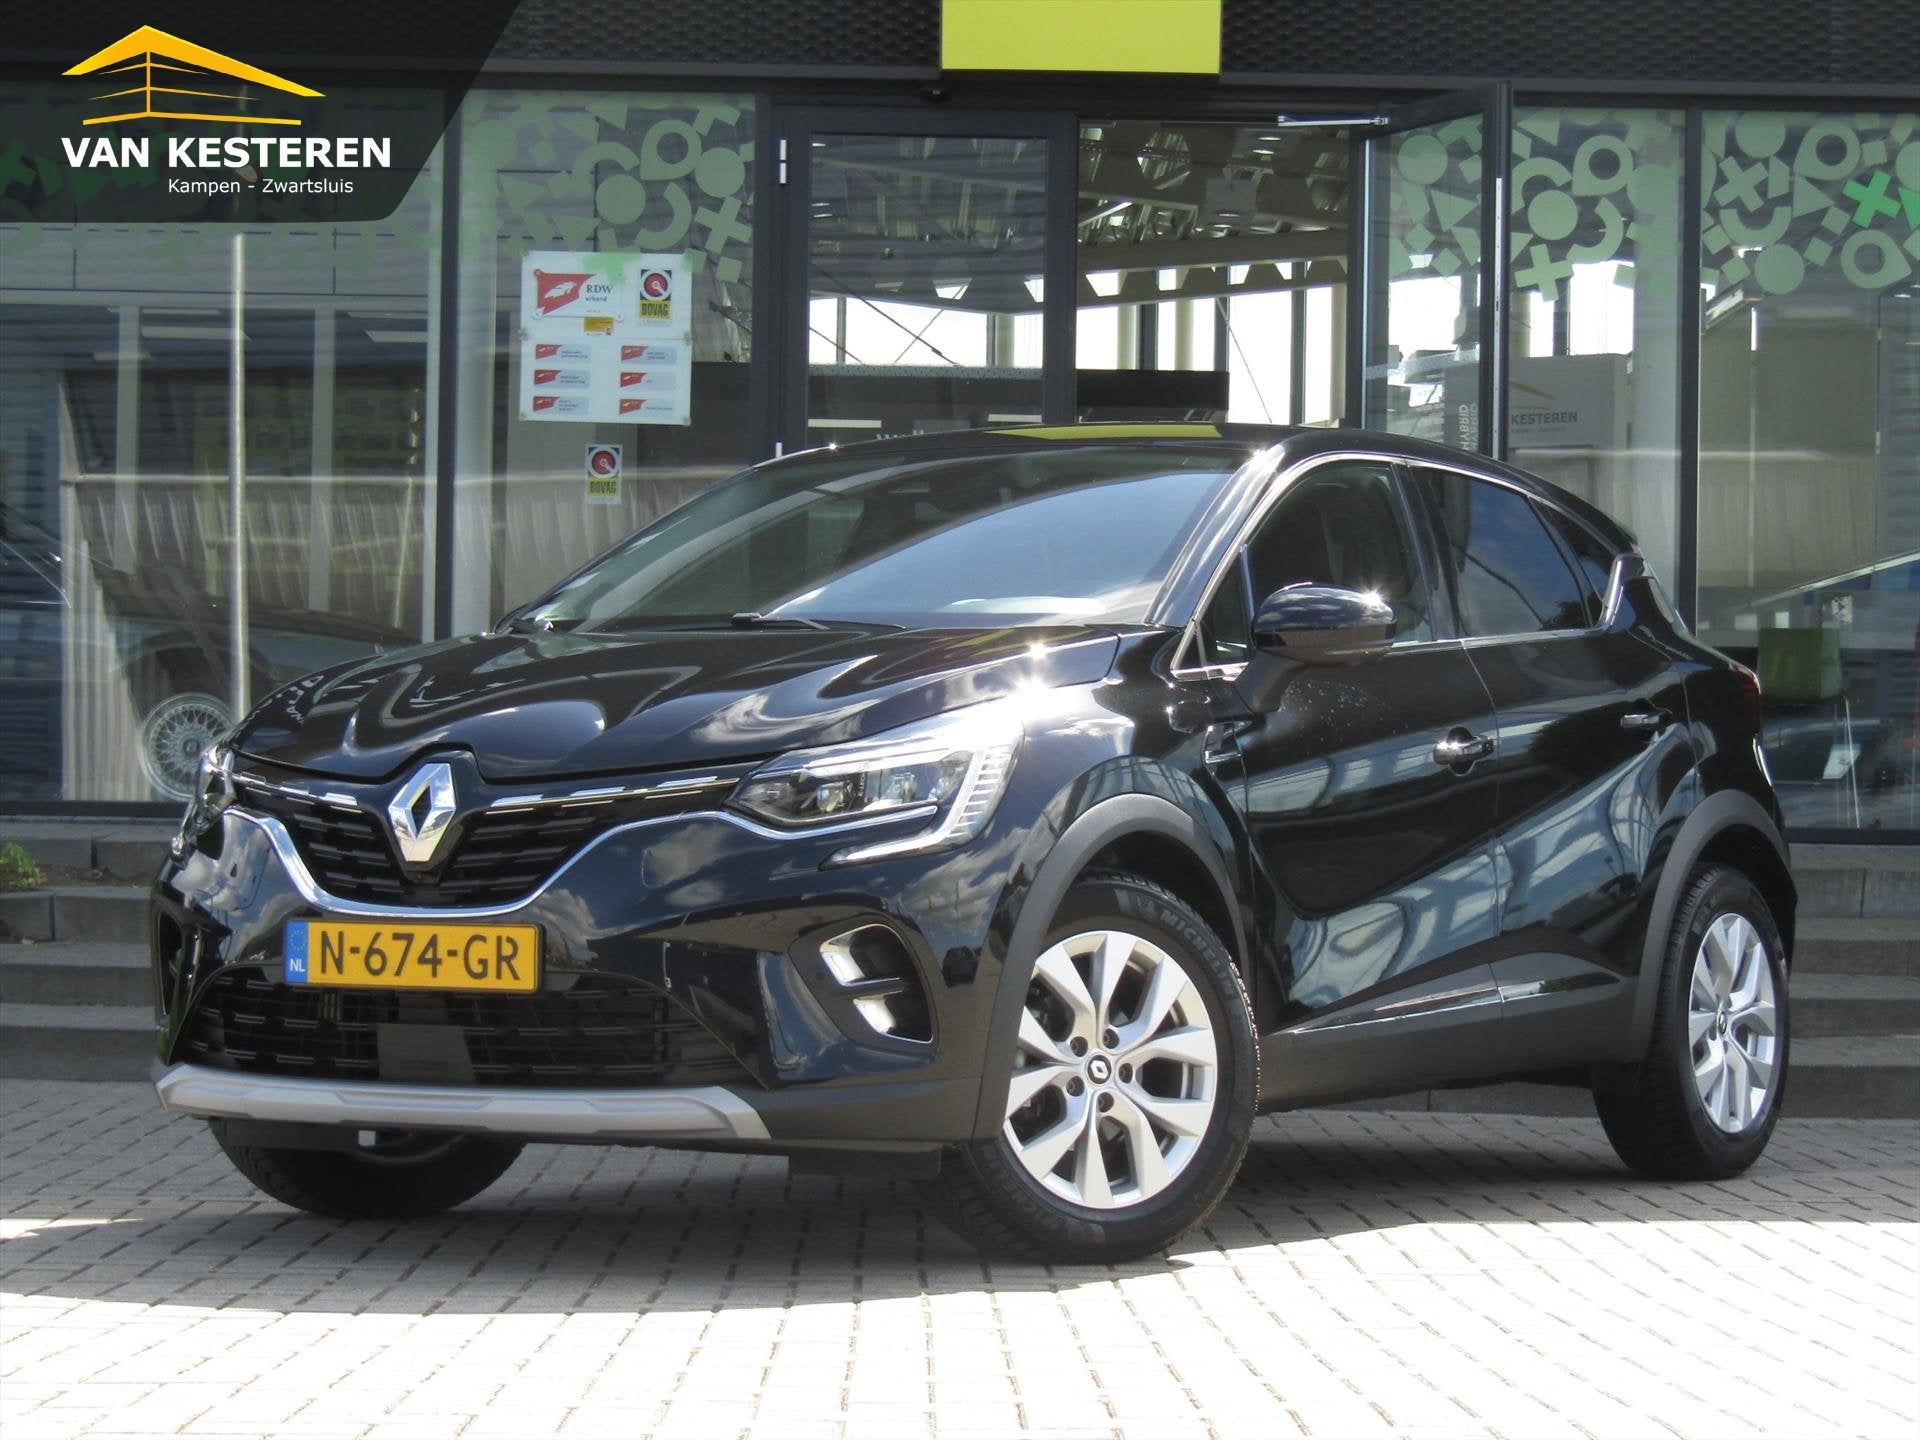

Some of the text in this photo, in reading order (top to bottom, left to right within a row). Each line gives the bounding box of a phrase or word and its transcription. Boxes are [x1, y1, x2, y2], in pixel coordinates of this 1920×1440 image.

[586, 284, 613, 294] RDW
[641, 303, 669, 317] BOVAG
[1511, 411, 1578, 425] KESTEREN
[590, 481, 617, 495] BOVAG
[320, 930, 521, 981] N-674-GR
[1160, 909, 1239, 999] MICHELIN
[290, 958, 306, 972] NL
